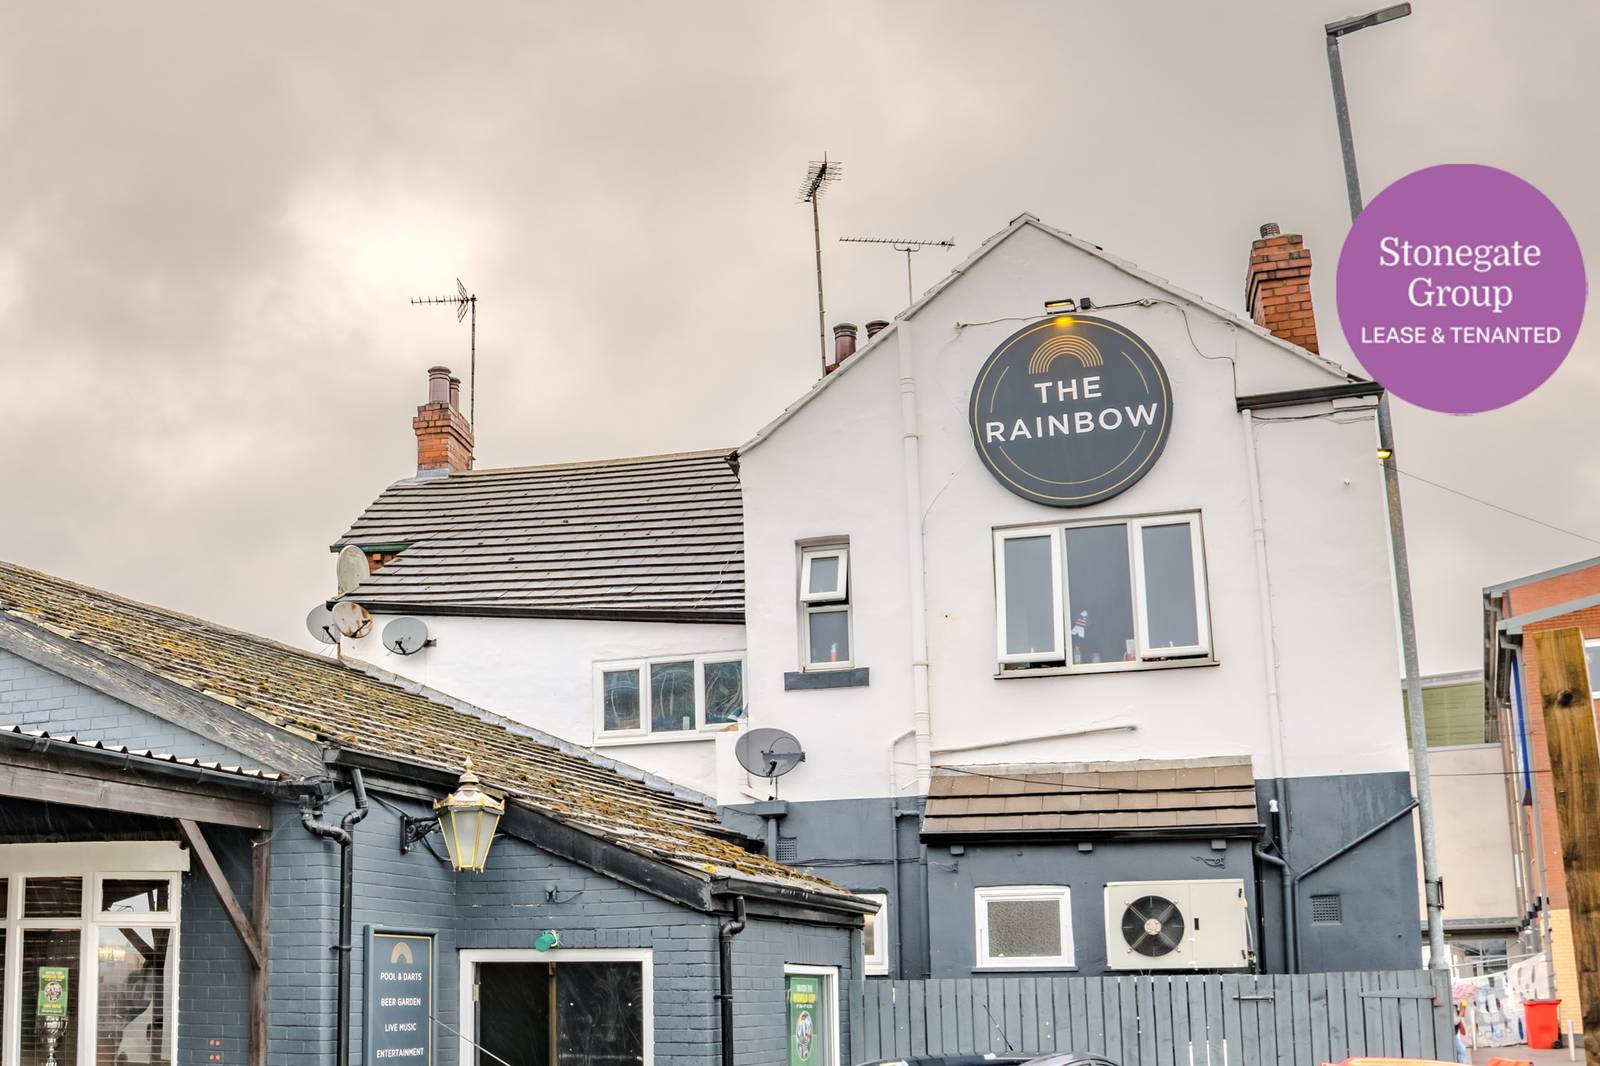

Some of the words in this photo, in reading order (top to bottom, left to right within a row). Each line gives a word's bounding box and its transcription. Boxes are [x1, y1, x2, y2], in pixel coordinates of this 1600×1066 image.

[1034, 376, 1102, 404] THE
[985, 403, 1158, 443] RAINBOW
[380, 972, 396, 981] POOL
[398, 972, 402, 981] &
[403, 972, 422, 981] DARTS
[380, 998, 396, 1007] BEER
[397, 997, 421, 1006] GARDEN
[384, 1023, 398, 1032] LIVE
[399, 1023, 417, 1032] MUSIC
[376, 1048, 424, 1058] ENTERTAINMENT
